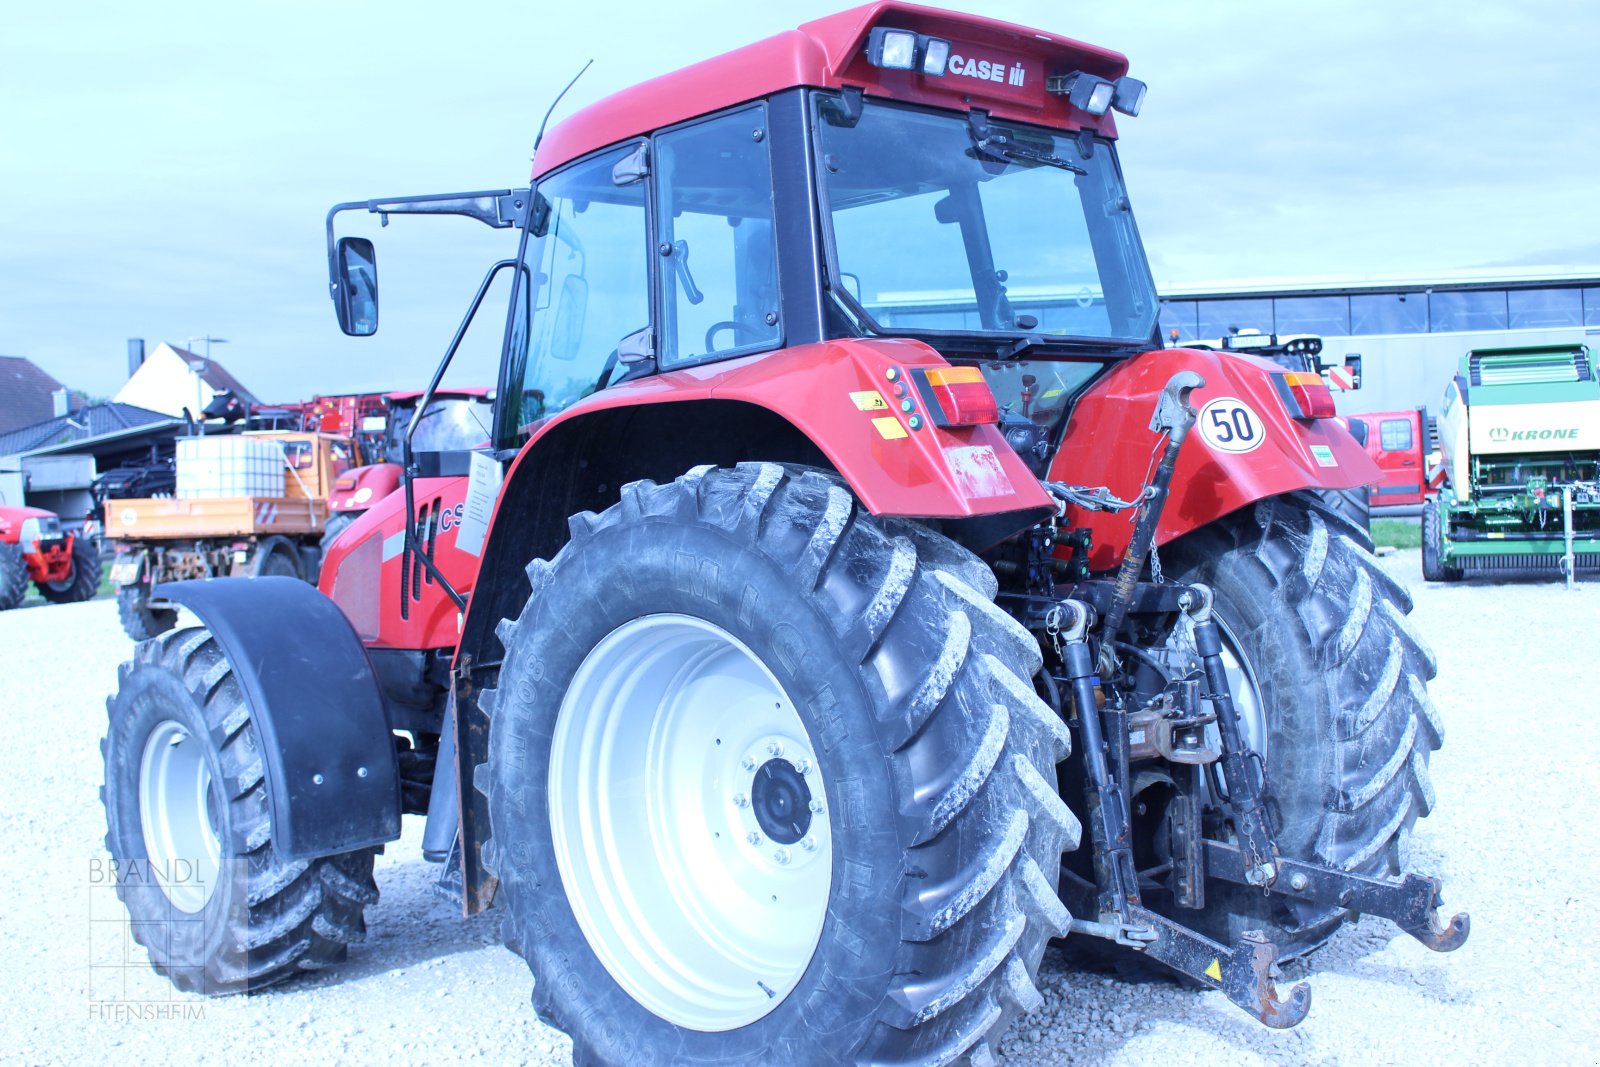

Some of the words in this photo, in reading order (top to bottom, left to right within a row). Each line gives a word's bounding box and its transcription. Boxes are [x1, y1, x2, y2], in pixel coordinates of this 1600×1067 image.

[949, 55, 1005, 83] CASE
[1210, 407, 1254, 443] 50
[1511, 428, 1579, 441] KRONE
[674, 550, 874, 1031] MICHELIN
